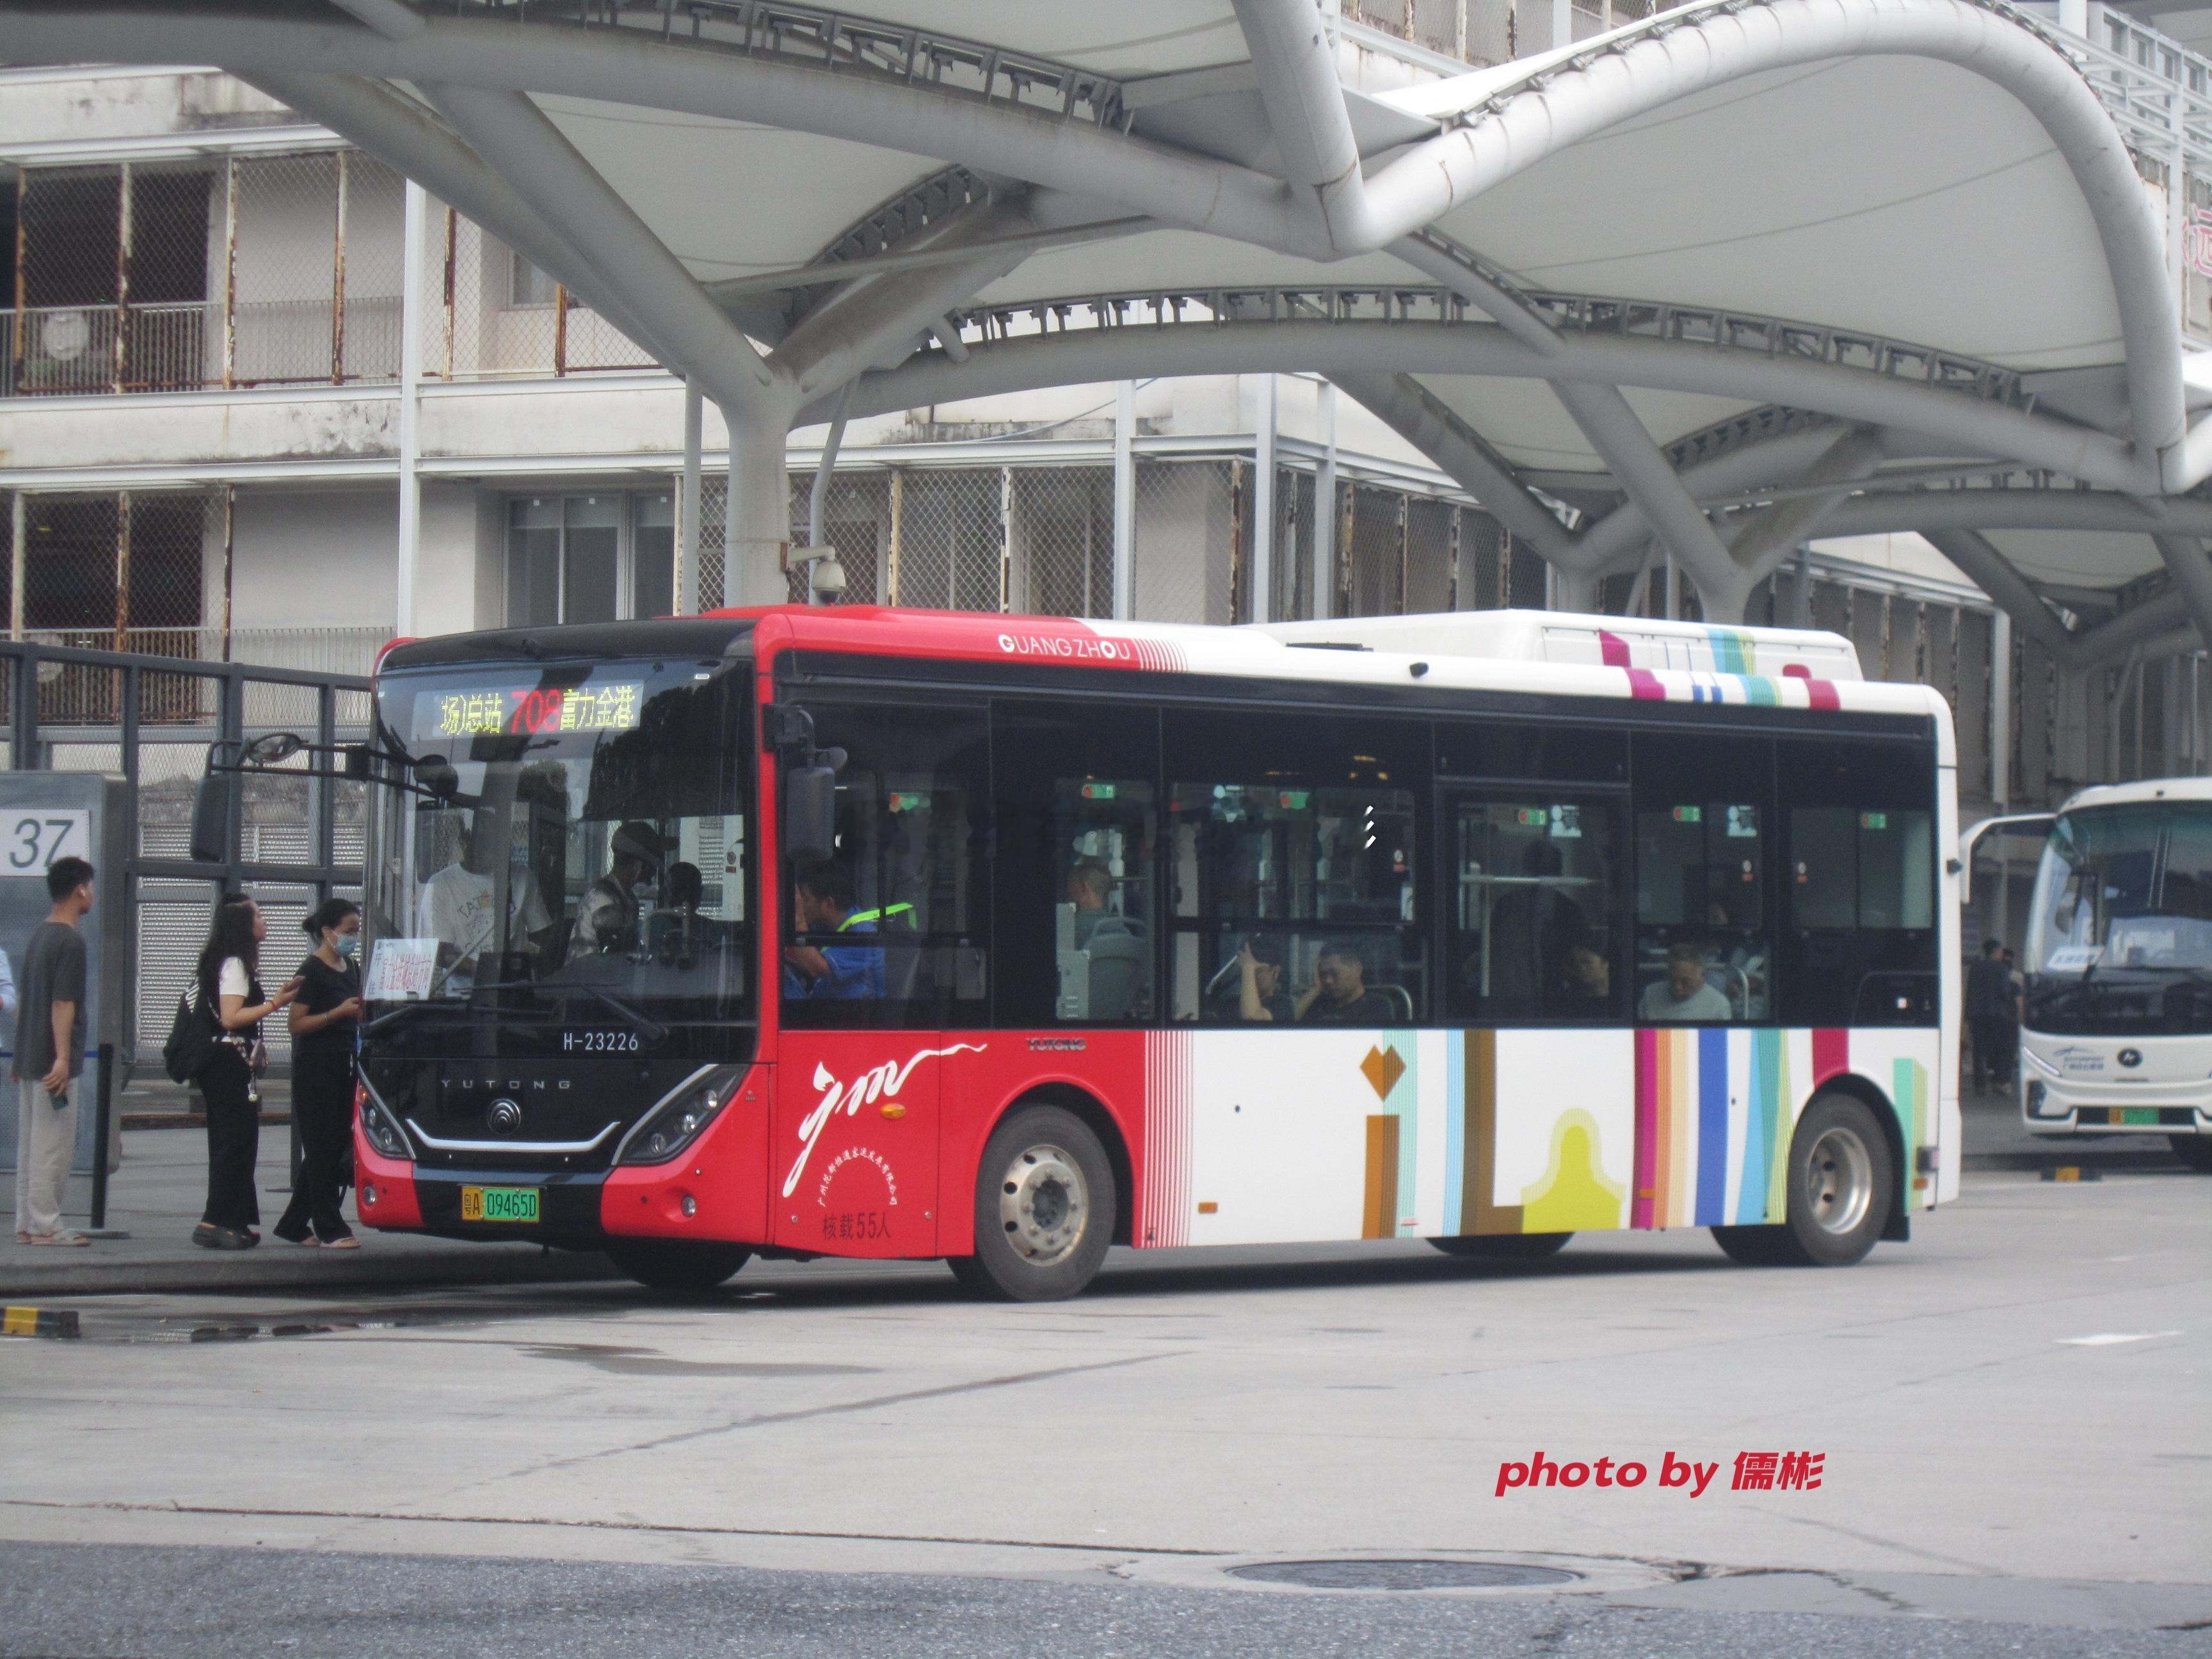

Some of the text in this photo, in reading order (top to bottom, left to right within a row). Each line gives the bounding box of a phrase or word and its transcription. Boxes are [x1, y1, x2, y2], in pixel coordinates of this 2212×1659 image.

[998, 634, 1130, 660] GUANGZHOU
[510, 688, 561, 733] 708
[560, 685, 635, 730] 富力金港
[9, 818, 74, 869] 37
[563, 1032, 639, 1051] H-23226
[1025, 1038, 1087, 1052] YUTONG
[441, 1079, 570, 1089] YUTONG
[463, 1192, 536, 1217] 粤A 09465D
[822, 1212, 891, 1240] 核载55人
